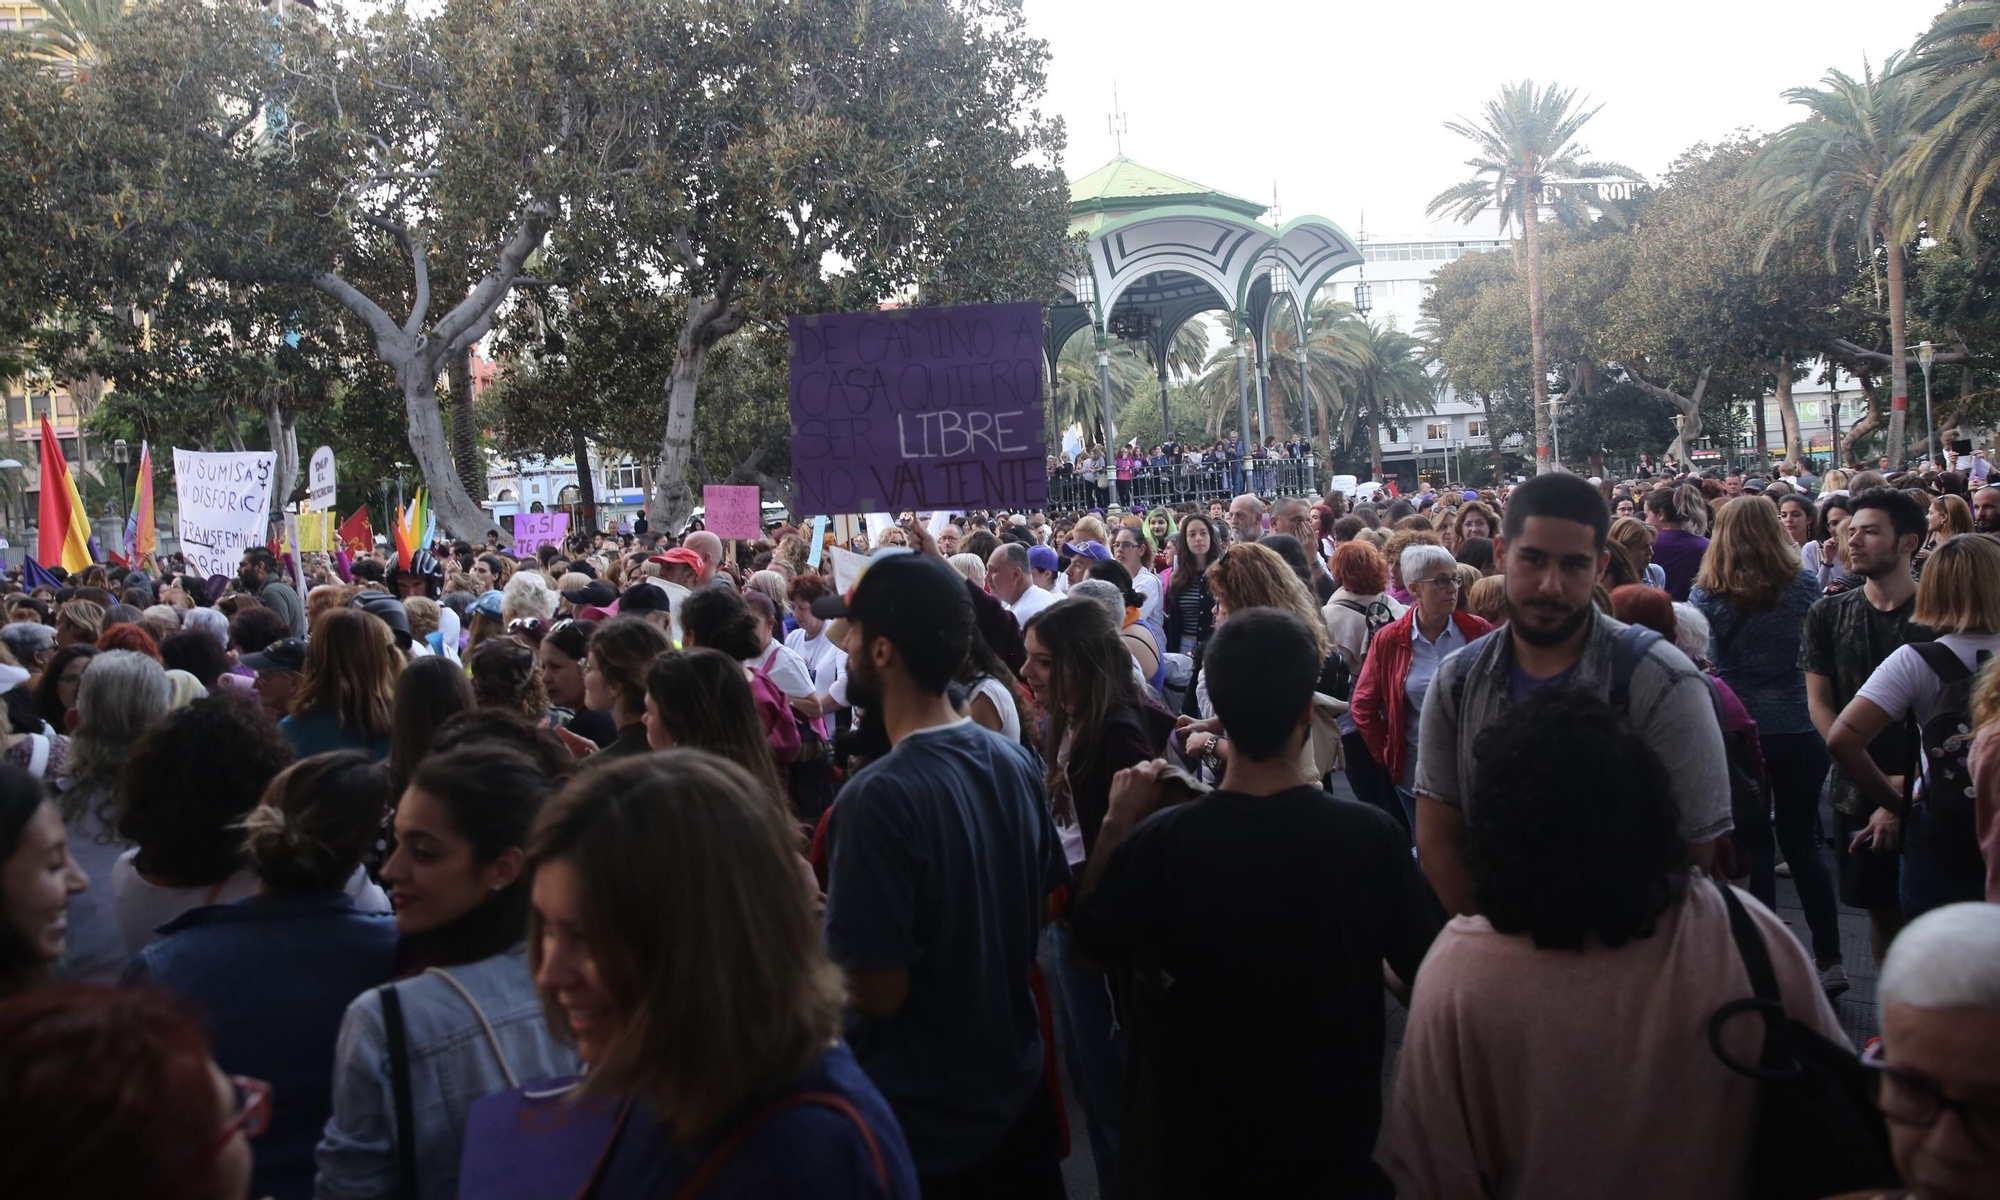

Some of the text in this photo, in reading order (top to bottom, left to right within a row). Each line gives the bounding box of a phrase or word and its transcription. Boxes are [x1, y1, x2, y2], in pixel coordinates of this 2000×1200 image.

[799, 316, 1038, 365] DE CAMINO A
[898, 359, 1038, 411] QUIERO
[799, 410, 1028, 460] SER LIBRE
[197, 458, 253, 482] SUMISA
[318, 474, 325, 483] EL
[797, 455, 1047, 508] NO VALIENTE
[210, 547, 226, 556] CON
[518, 540, 533, 555] TE
